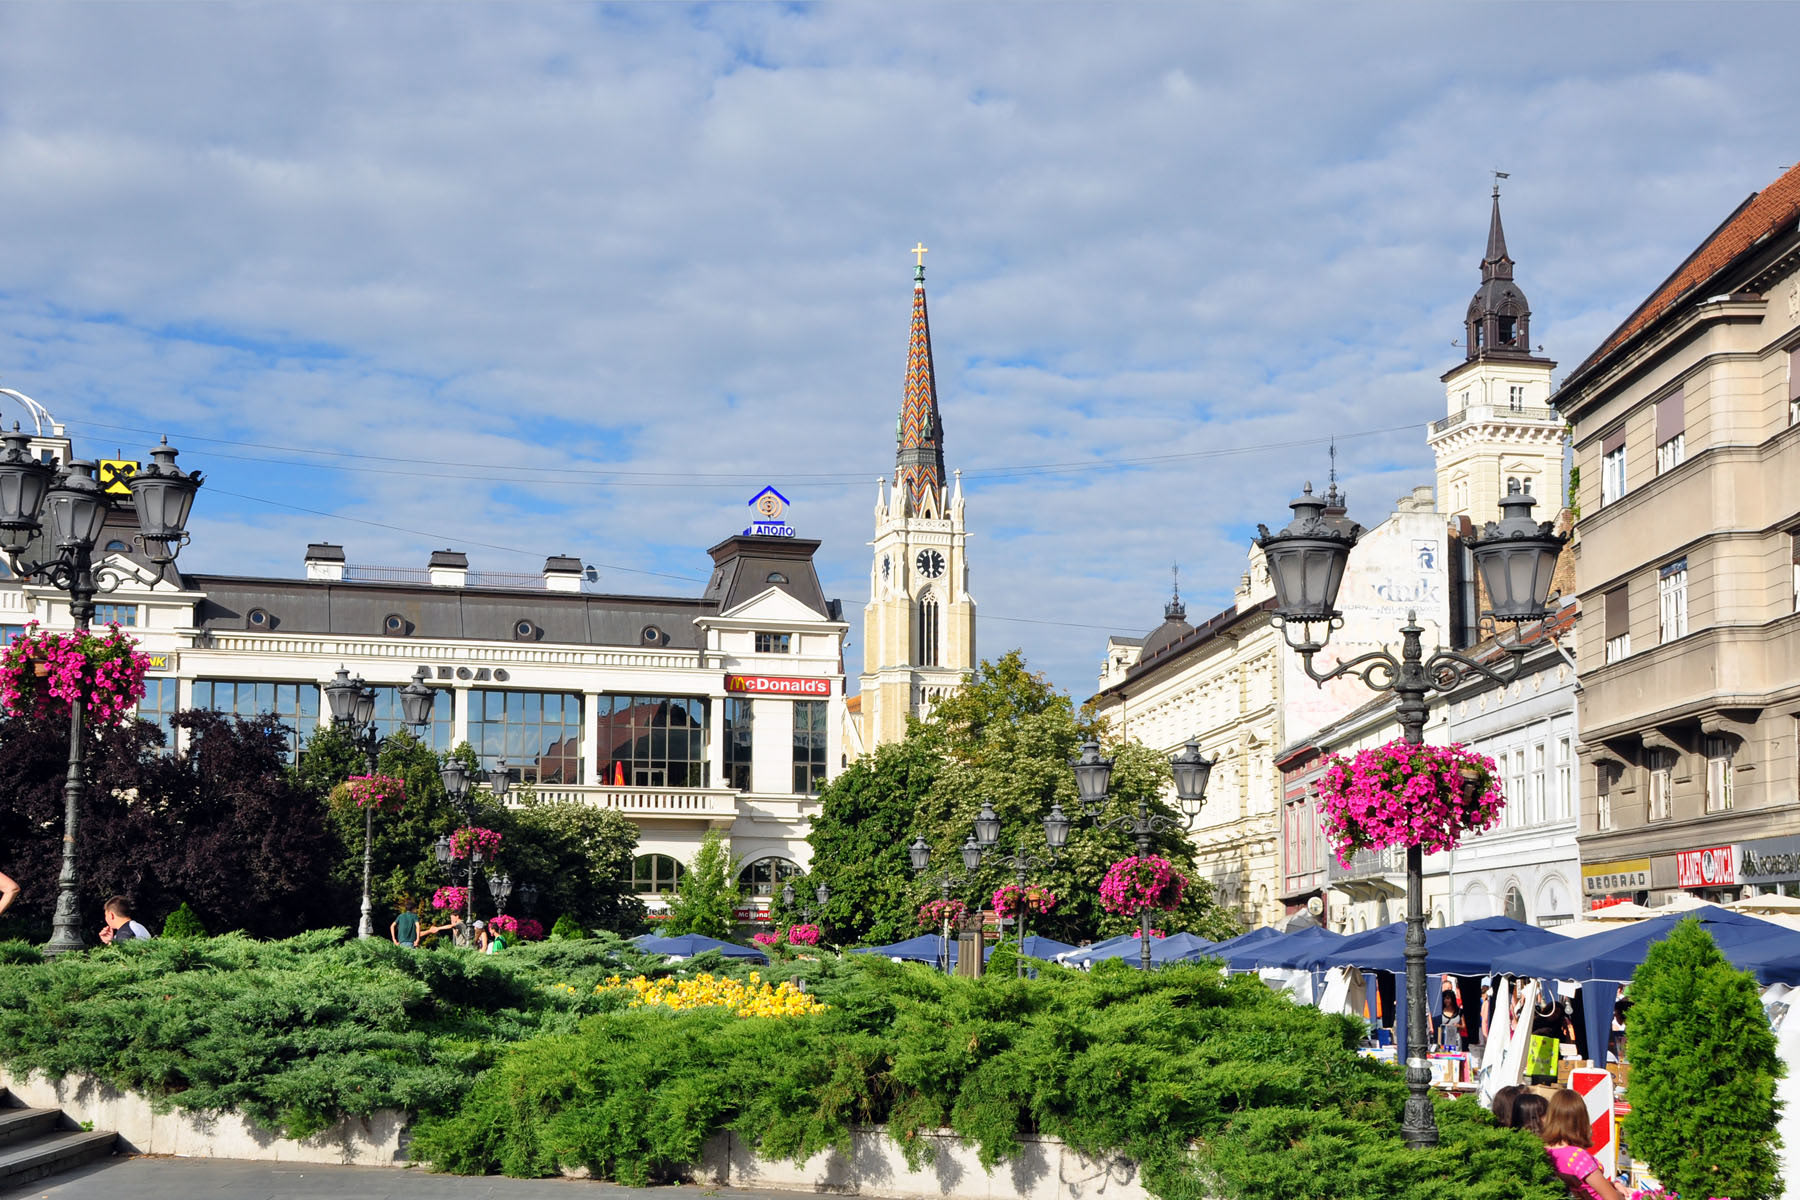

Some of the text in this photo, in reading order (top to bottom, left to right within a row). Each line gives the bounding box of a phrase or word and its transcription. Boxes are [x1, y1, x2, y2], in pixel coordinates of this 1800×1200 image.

[756, 525, 794, 536] АПОЛО
[416, 665, 510, 682] АПОЛО
[729, 677, 827, 692] McDonald's
[1678, 852, 1702, 886] PLANET
[1587, 872, 1646, 890] BEOGRAD
